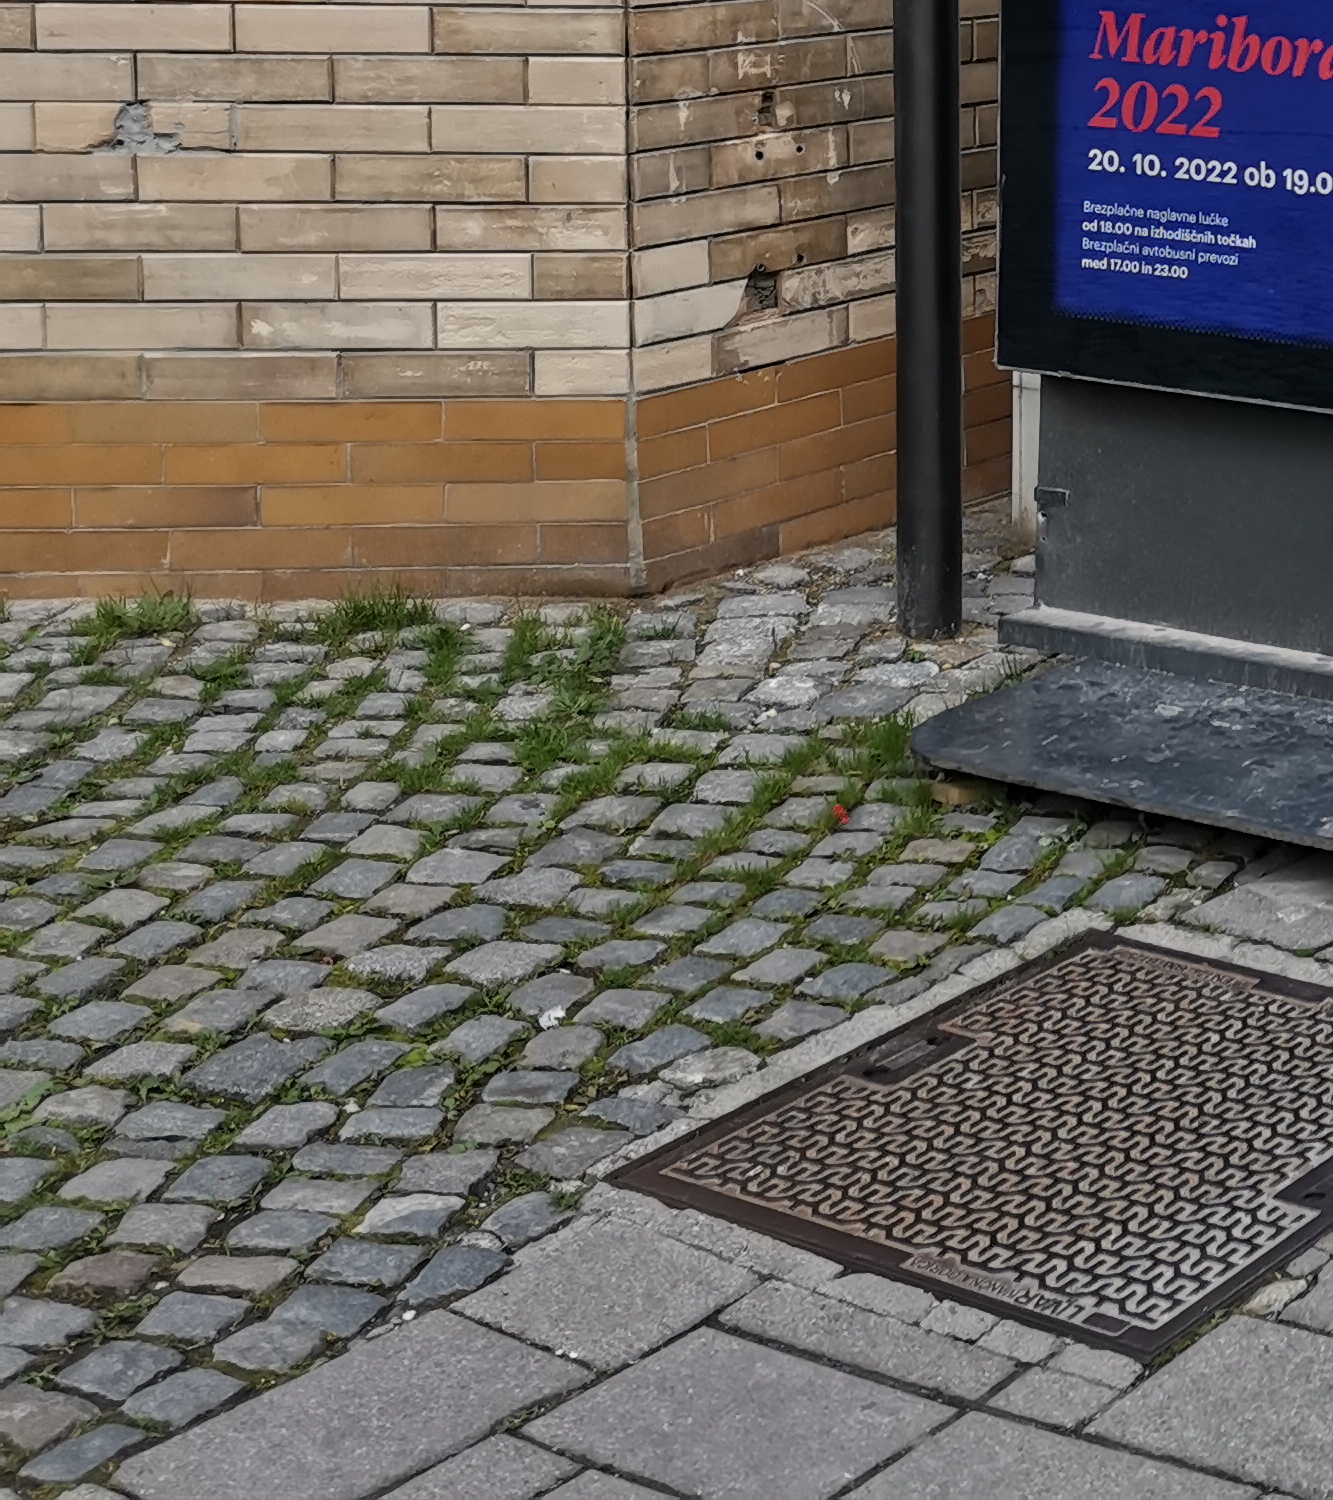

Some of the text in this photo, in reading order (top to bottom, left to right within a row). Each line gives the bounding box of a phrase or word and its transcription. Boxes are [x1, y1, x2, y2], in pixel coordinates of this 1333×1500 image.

[1087, 77, 1224, 138] 2022
[1087, 148, 1126, 174] 20.
[1131, 153, 1167, 178] 10.
[1174, 156, 1238, 184] 2022
[1243, 161, 1277, 189] ob
[1083, 200, 1229, 228] Brezplačne naglavne lučke
[1082, 220, 1257, 249] od 18.00 na izhodiščnih točkah
[1081, 237, 1240, 267] Brezplačni avtobusni prevozi
[1081, 257, 1189, 280] med 17.00 in 23.00
